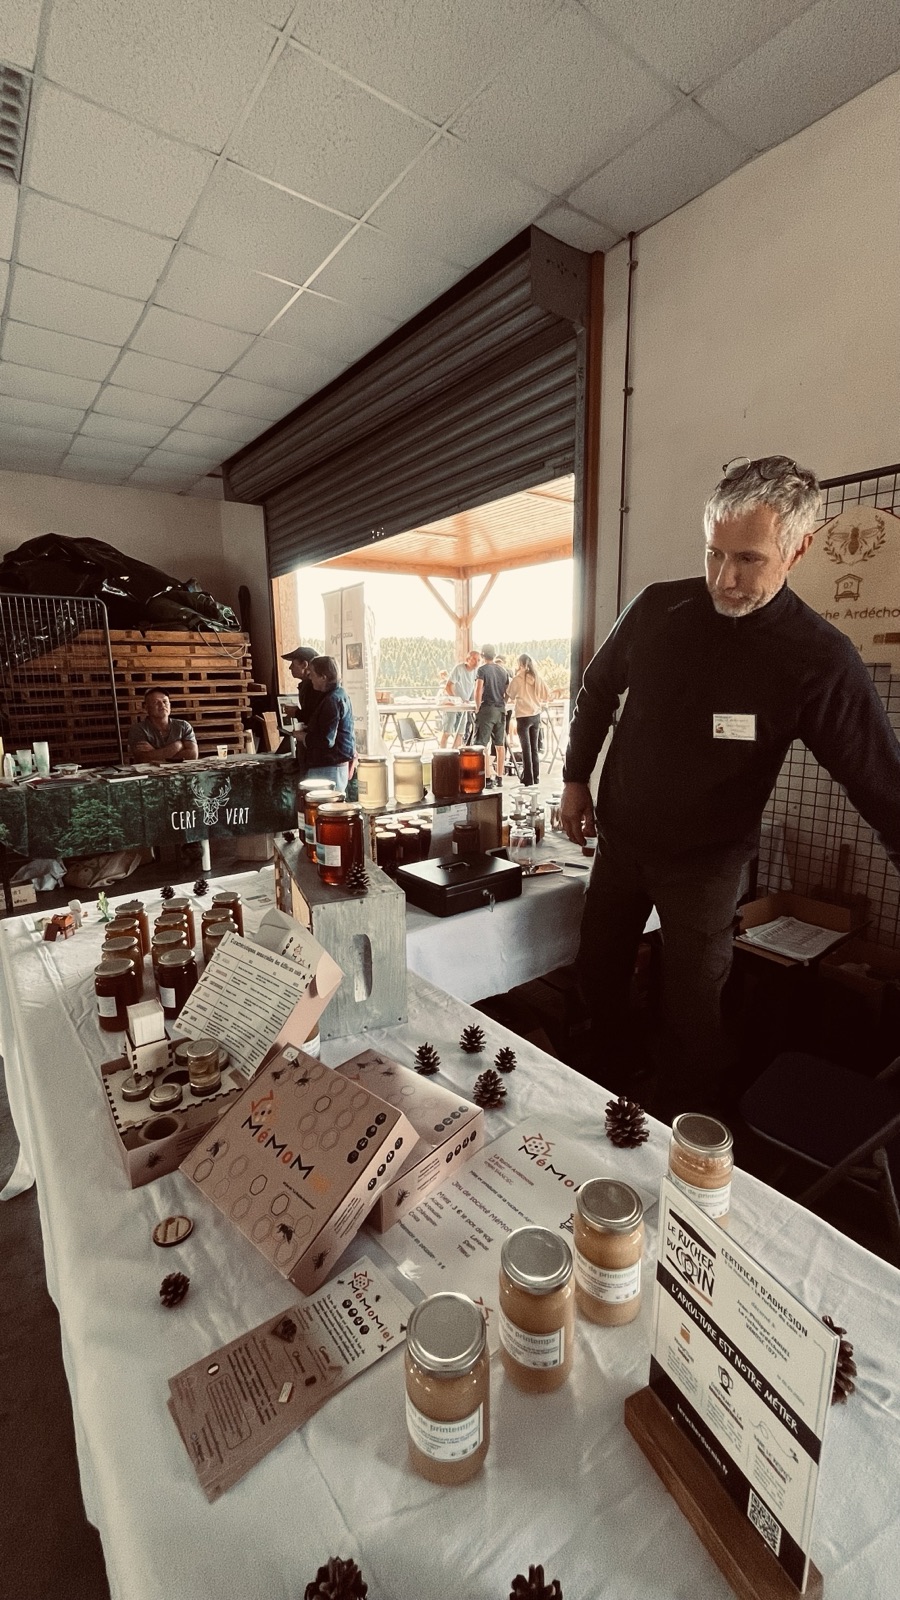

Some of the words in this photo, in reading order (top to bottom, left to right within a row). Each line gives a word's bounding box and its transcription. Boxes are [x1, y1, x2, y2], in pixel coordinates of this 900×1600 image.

[820, 609, 840, 620] he
[171, 810, 196, 830] CERF
[226, 807, 250, 825] VERT
[452, 1181, 463, 1191] Jeu
[462, 1189, 471, 1197] de
[469, 1196, 490, 1214] société
[667, 1237, 676, 1251] DU
[668, 1222, 676, 1236] LE
[678, 1230, 715, 1277] RUCHER
[721, 1247, 758, 1287] CERTIFICAT
[760, 1286, 808, 1337] D'ADHÉSION
[347, 1280, 395, 1343] MéMoMiel
[515, 1331, 556, 1345] printemps
[671, 1283, 718, 1341] L'APICULTURE
[718, 1336, 734, 1358] EST
[763, 1389, 799, 1435] MÉTIER
[429, 1419, 475, 1433] printemps
